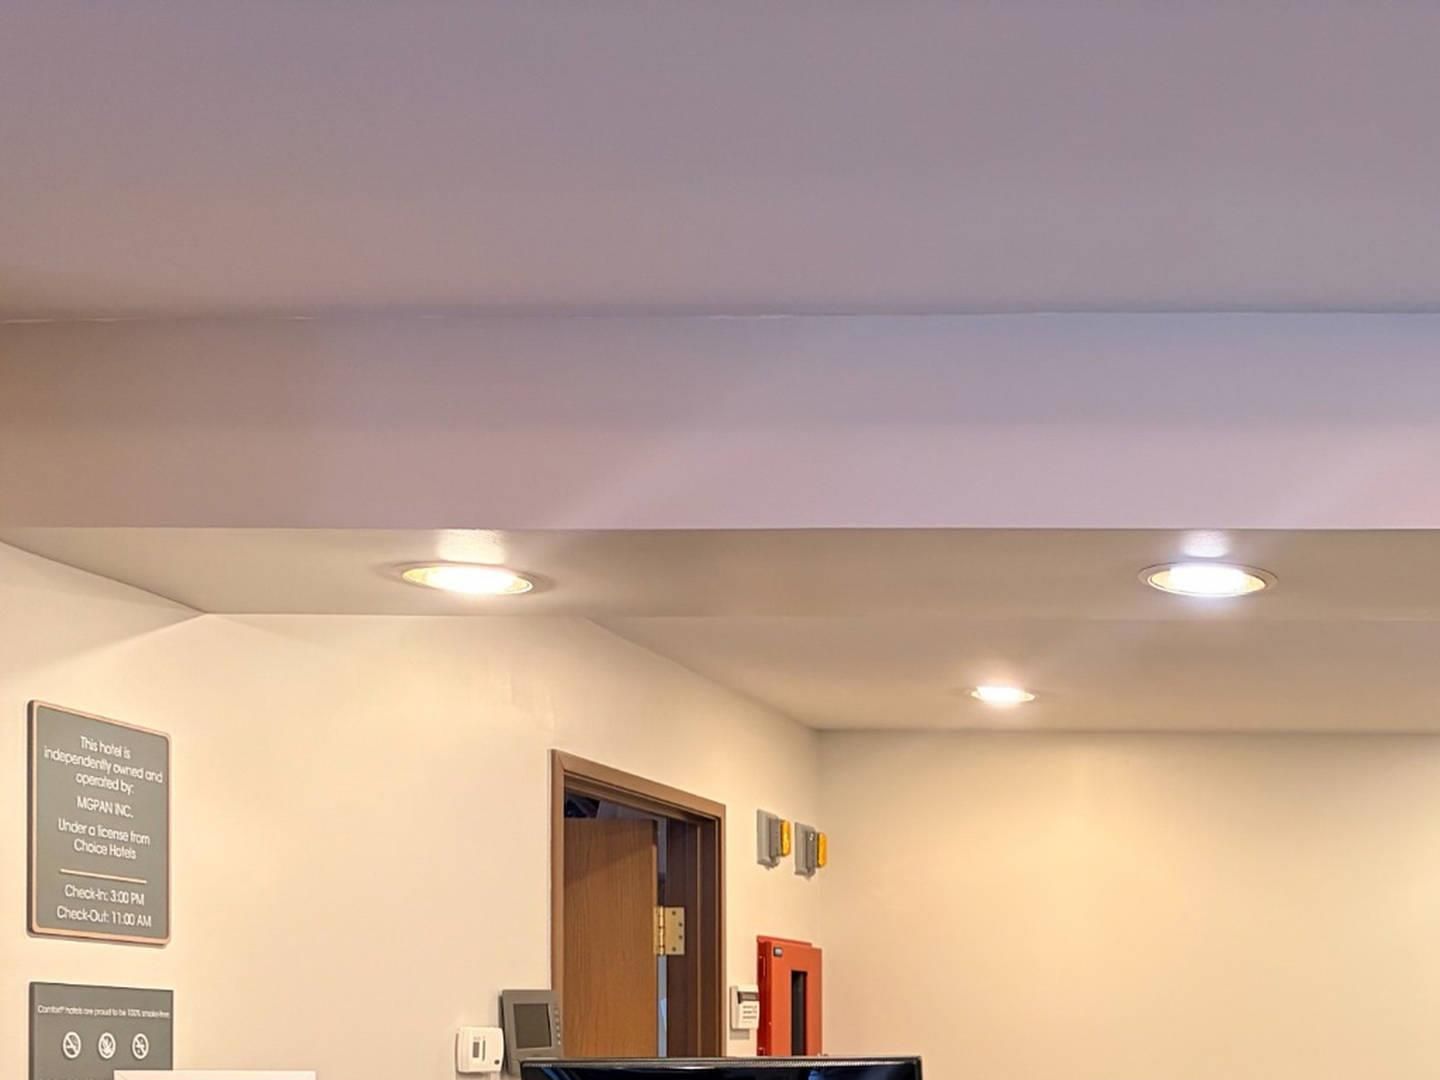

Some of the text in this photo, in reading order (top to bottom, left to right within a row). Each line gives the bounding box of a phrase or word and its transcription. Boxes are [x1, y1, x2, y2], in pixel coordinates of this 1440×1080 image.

[80, 735, 131, 759] This hotel is
[44, 745, 163, 783] independently owned and
[75, 773, 119, 791] operated
[76, 795, 134, 818] MGPAN INC.
[58, 817, 151, 846] Under a license from
[74, 838, 137, 860] Choice Hotels
[64, 883, 145, 905] Check-In: 3:00 PM
[56, 905, 152, 927] Check-Out: 11:00 AM
